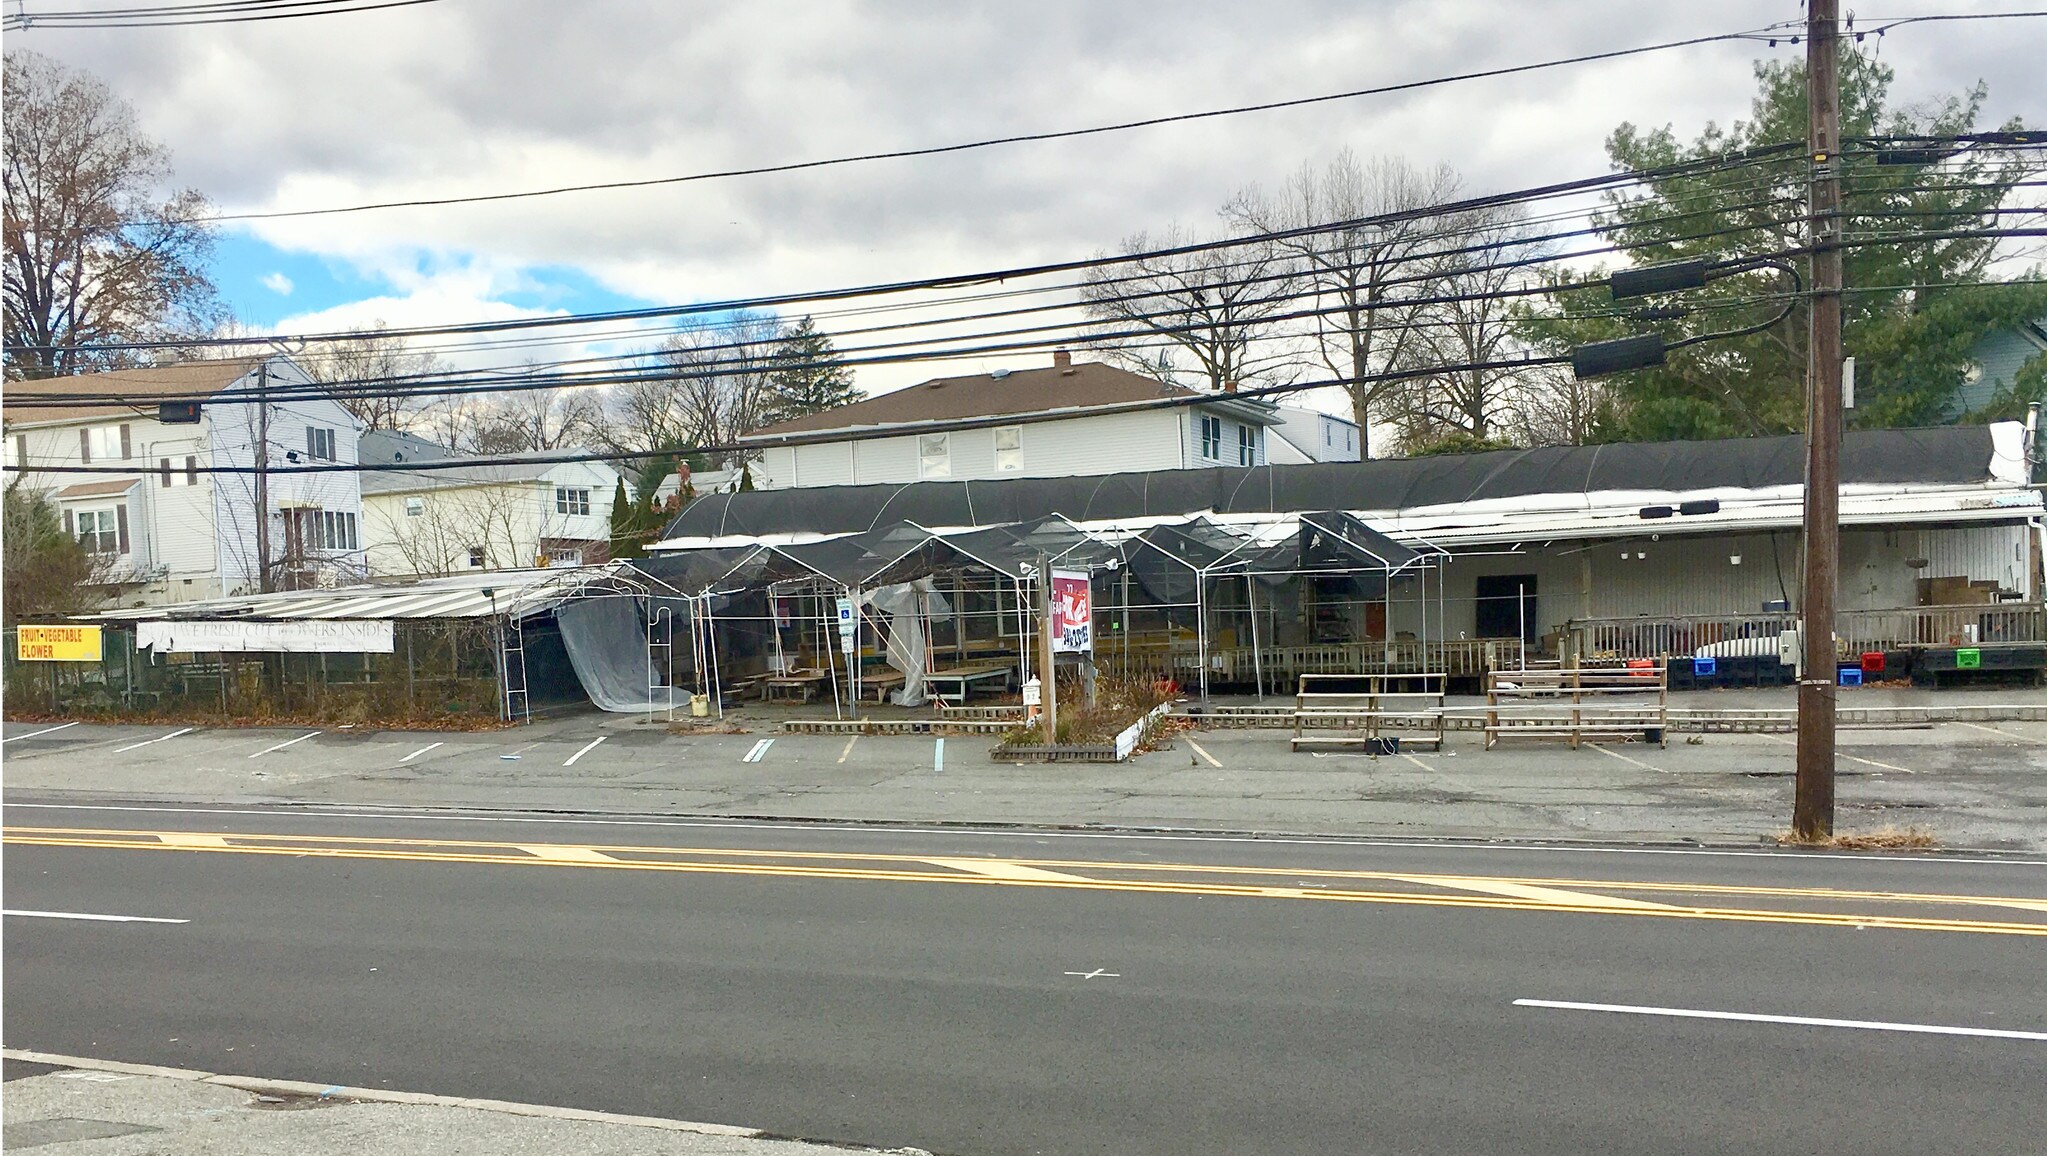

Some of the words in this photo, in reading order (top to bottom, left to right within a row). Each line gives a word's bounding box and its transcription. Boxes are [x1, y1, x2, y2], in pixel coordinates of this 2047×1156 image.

[21, 629, 40, 643] FRUIT
[44, 629, 82, 643] VEGETABLE
[21, 645, 54, 659] FLOWER
